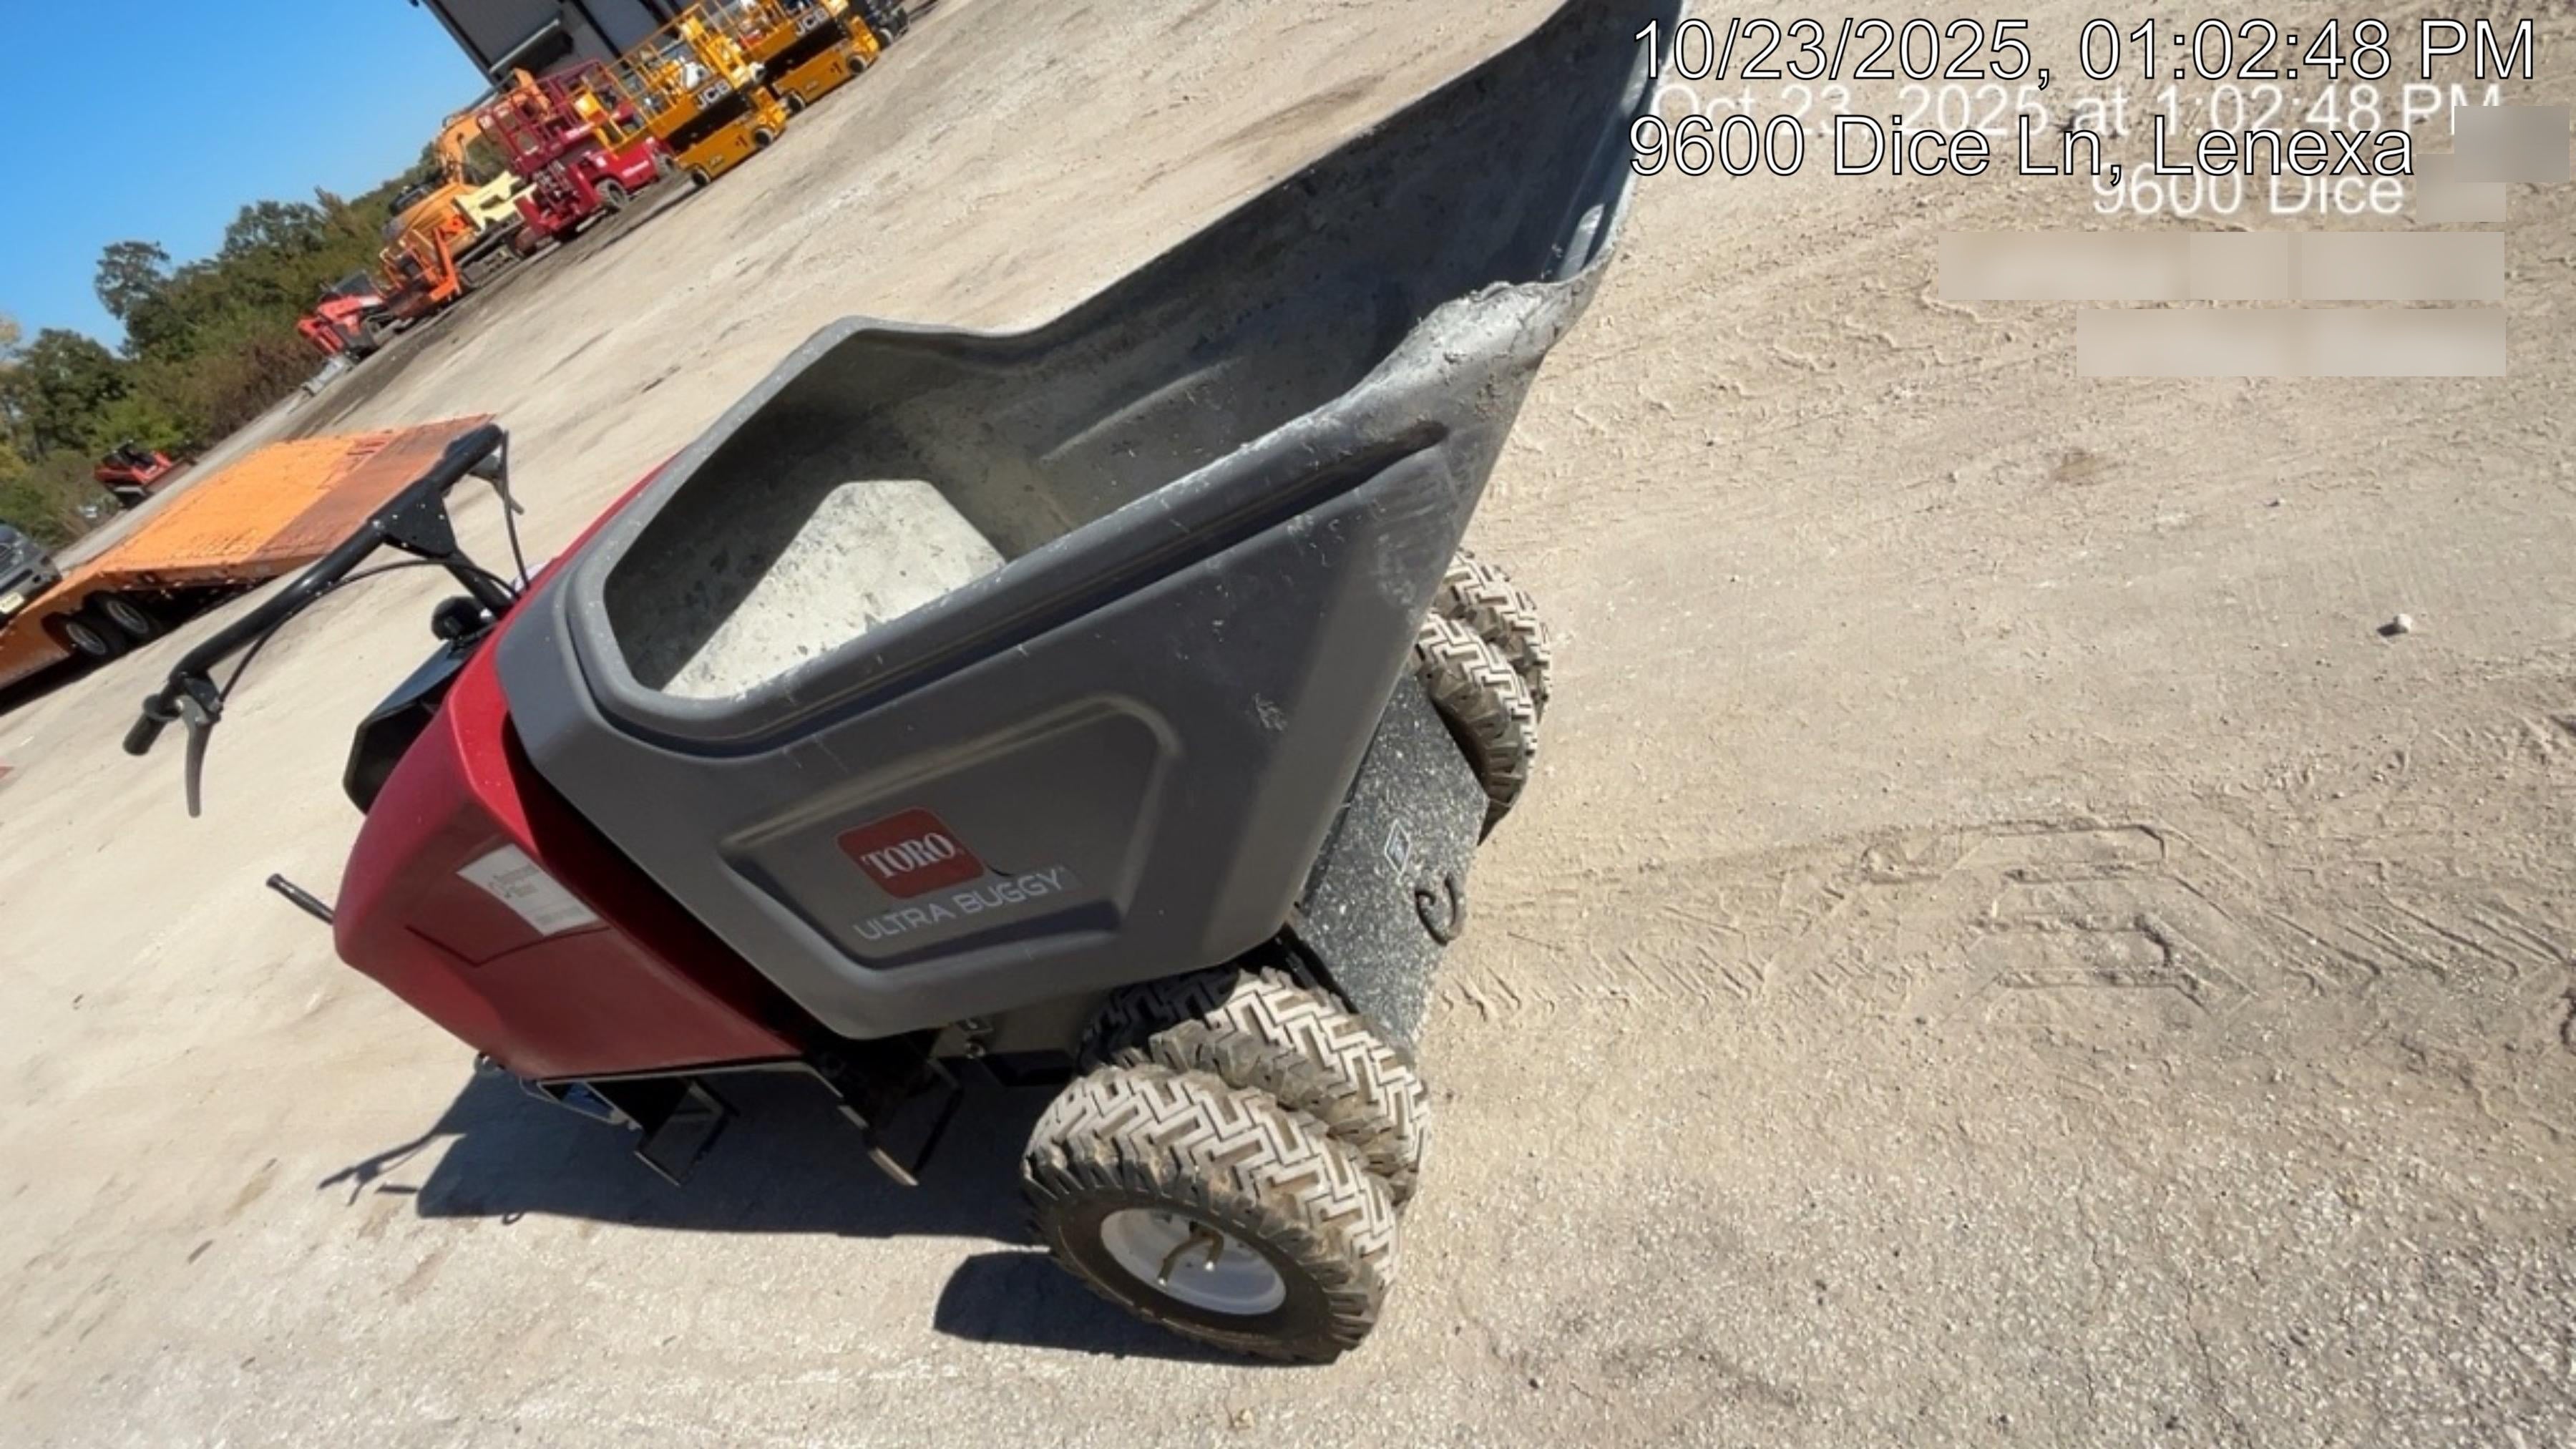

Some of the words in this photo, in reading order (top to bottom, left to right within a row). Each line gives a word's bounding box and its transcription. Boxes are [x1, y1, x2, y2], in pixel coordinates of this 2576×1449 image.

[796, 7, 830, 37] JCB
[697, 79, 731, 110] JCB
[860, 832, 956, 878] TORO
[852, 902, 957, 940] ULTRA
